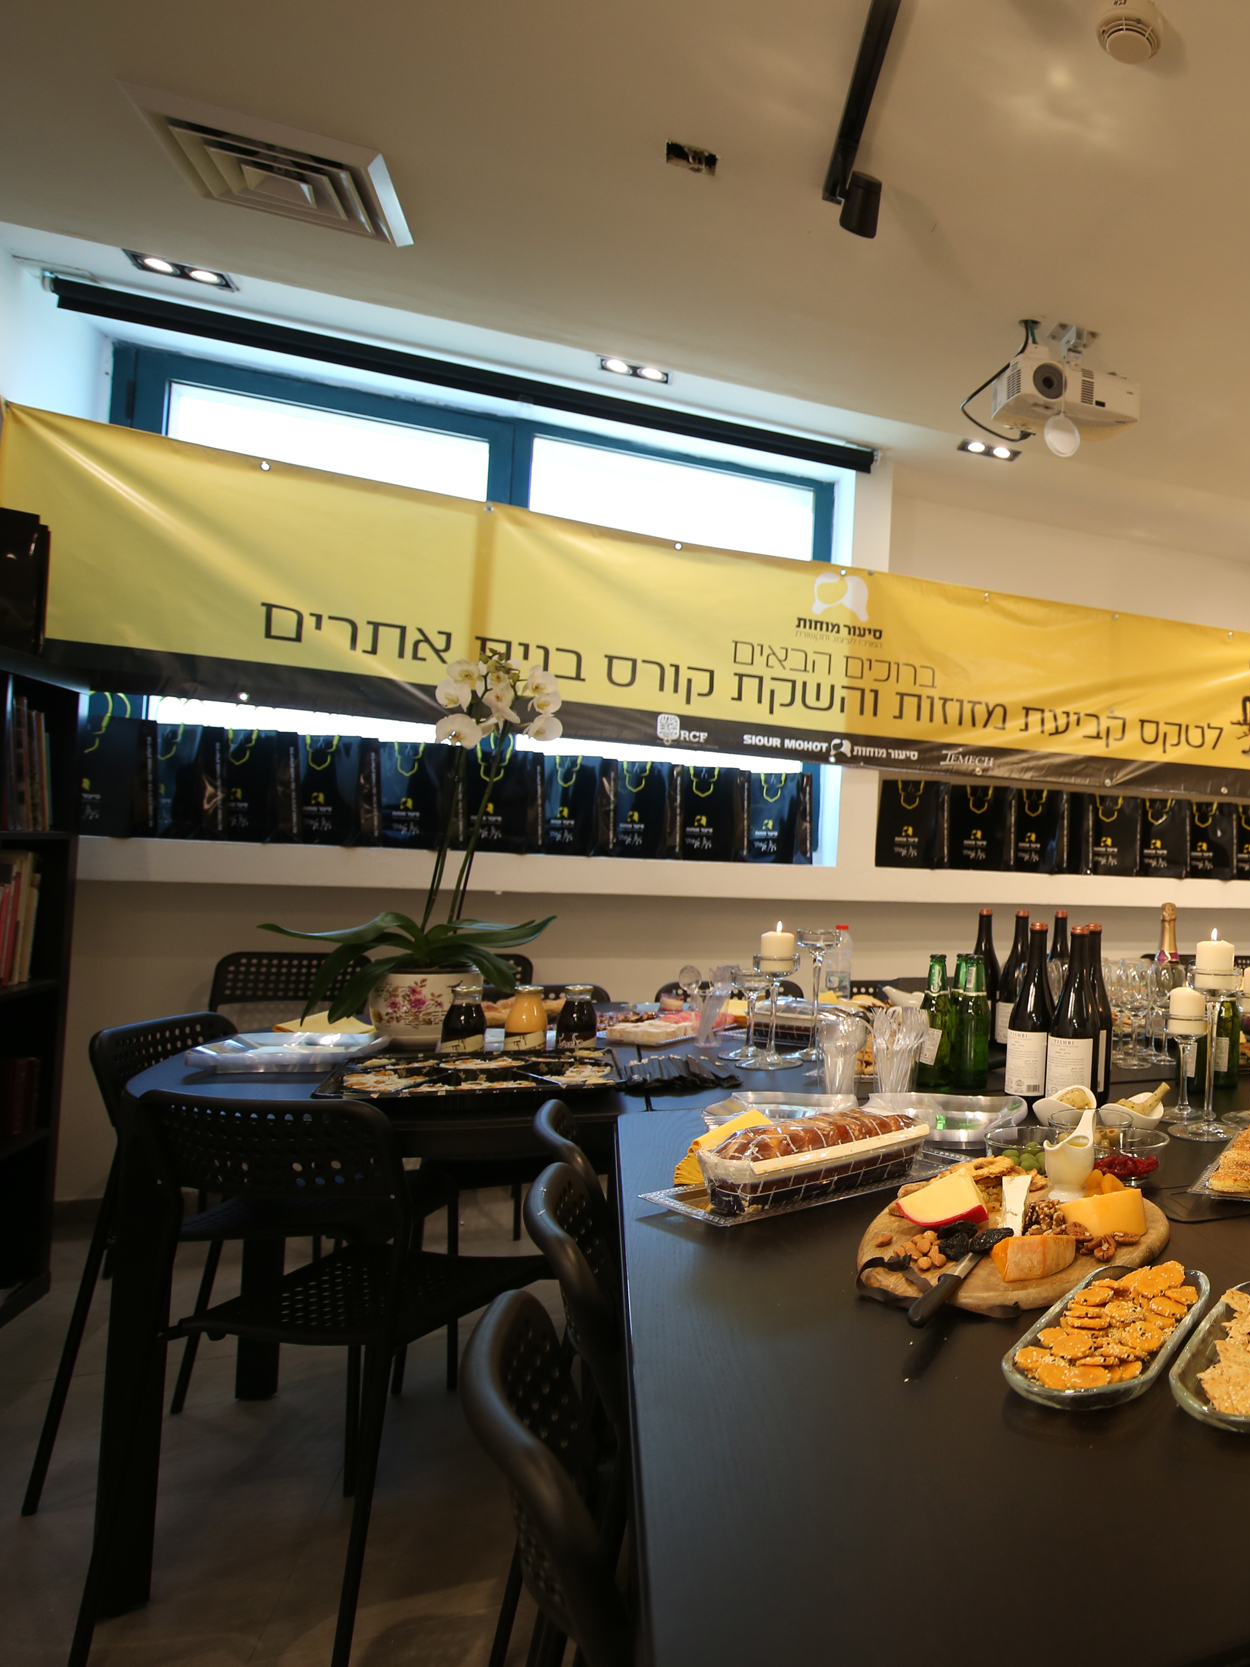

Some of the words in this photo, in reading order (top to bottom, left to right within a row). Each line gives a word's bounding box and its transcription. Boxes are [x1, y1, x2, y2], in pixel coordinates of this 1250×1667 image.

[261, 602, 452, 664] אתרים
[795, 617, 841, 634] מוחות
[843, 623, 883, 640] סיעור
[732, 640, 832, 675] הבאים
[843, 655, 937, 688] ברוכים
[604, 654, 715, 705] קורס
[731, 672, 879, 717] והשקת
[892, 691, 1008, 730] מזוזות
[1019, 706, 1127, 748] קביעת
[680, 729, 708, 743] RCF
[743, 733, 781, 748] SIOUR
[784, 738, 828, 753] MOHOT
[853, 745, 887, 758] מוחות
[1139, 718, 1224, 753] לטקס
[888, 749, 918, 761] סיעור
